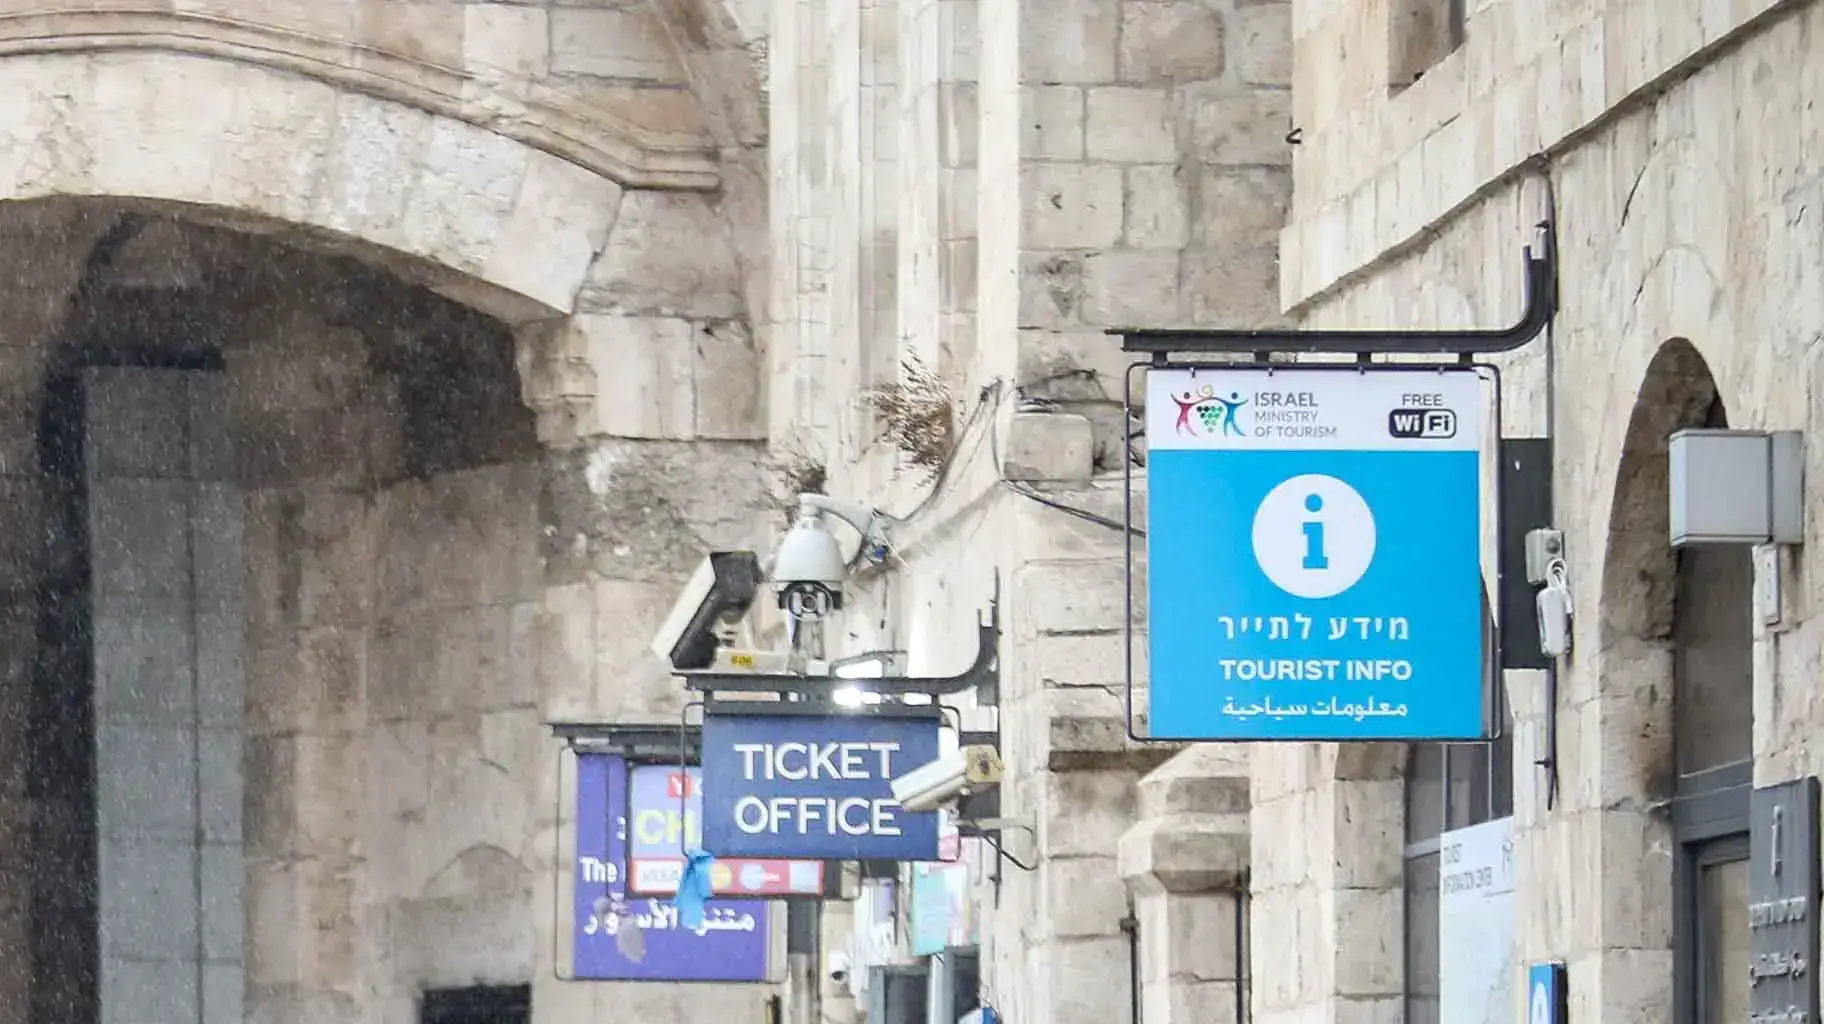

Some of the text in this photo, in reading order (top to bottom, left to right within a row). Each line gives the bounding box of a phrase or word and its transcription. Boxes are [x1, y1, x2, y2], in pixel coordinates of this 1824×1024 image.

[1254, 392, 1319, 407] ISRAEL
[1402, 394, 1443, 406] FREE
[1254, 411, 1318, 423] MINISTRY
[1254, 426, 1337, 438] OF TOURISM
[1218, 612, 1409, 641] מידע לתייר
[1219, 659, 1412, 681] TOURIST INFO
[1222, 697, 1408, 722] معلومات سياحية
[733, 743, 900, 780] TICKET
[733, 796, 902, 836] OFFICE
[581, 856, 618, 883] The
